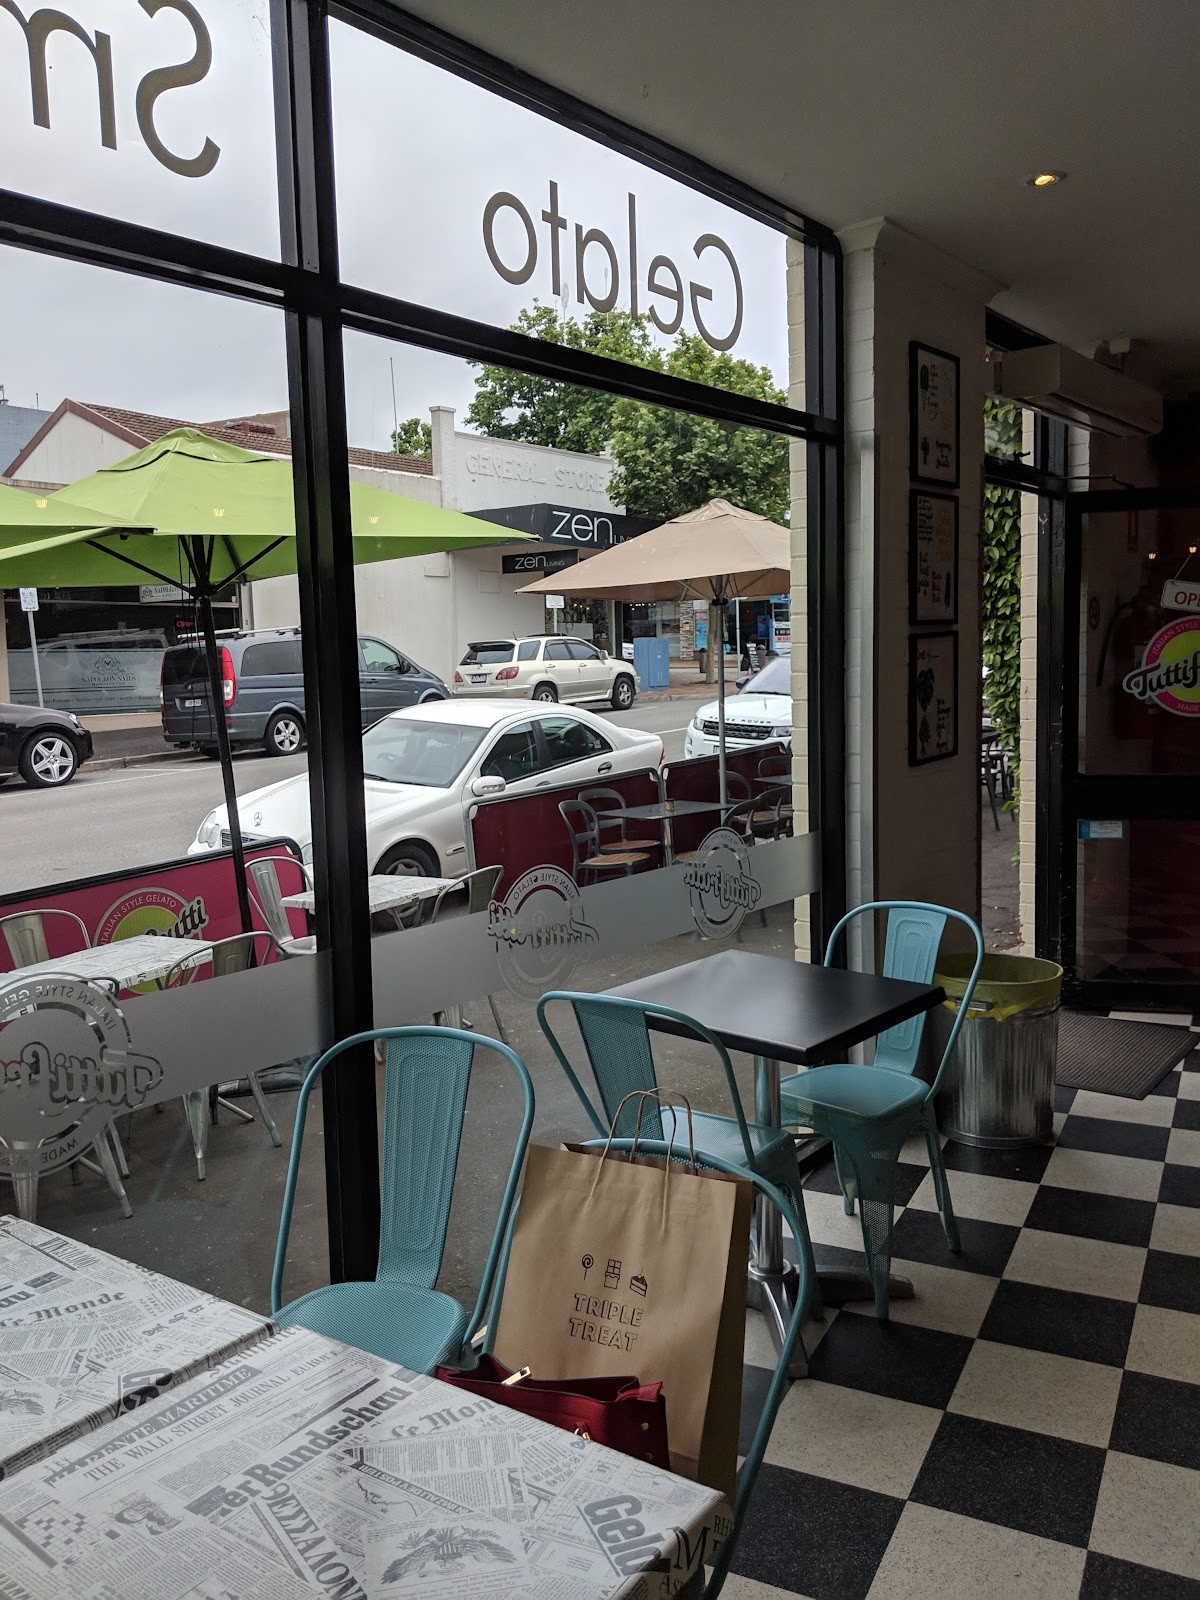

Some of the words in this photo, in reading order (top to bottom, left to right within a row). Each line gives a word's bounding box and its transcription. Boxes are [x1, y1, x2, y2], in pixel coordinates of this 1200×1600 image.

[465, 452, 546, 485] GENERAL
[554, 466, 606, 494] STORE
[551, 510, 614, 545] zen
[514, 555, 546, 569] zen
[1152, 628, 1175, 655] ITALIAN
[1175, 620, 1199, 633] STYLE
[100, 910, 122, 946] ITALIAN
[121, 896, 144, 914] STYLE
[145, 894, 178, 908] GELATO
[27, 1290, 128, 1323] Monde
[574, 1292, 645, 1328] TRIPLE
[569, 1316, 638, 1352] TREAT
[158, 1366, 252, 1427] MARITIME
[83, 1456, 125, 1483] THE
[124, 1435, 174, 1462] WALL
[171, 1404, 228, 1438] STREET
[232, 1374, 292, 1409] JOURNAL
